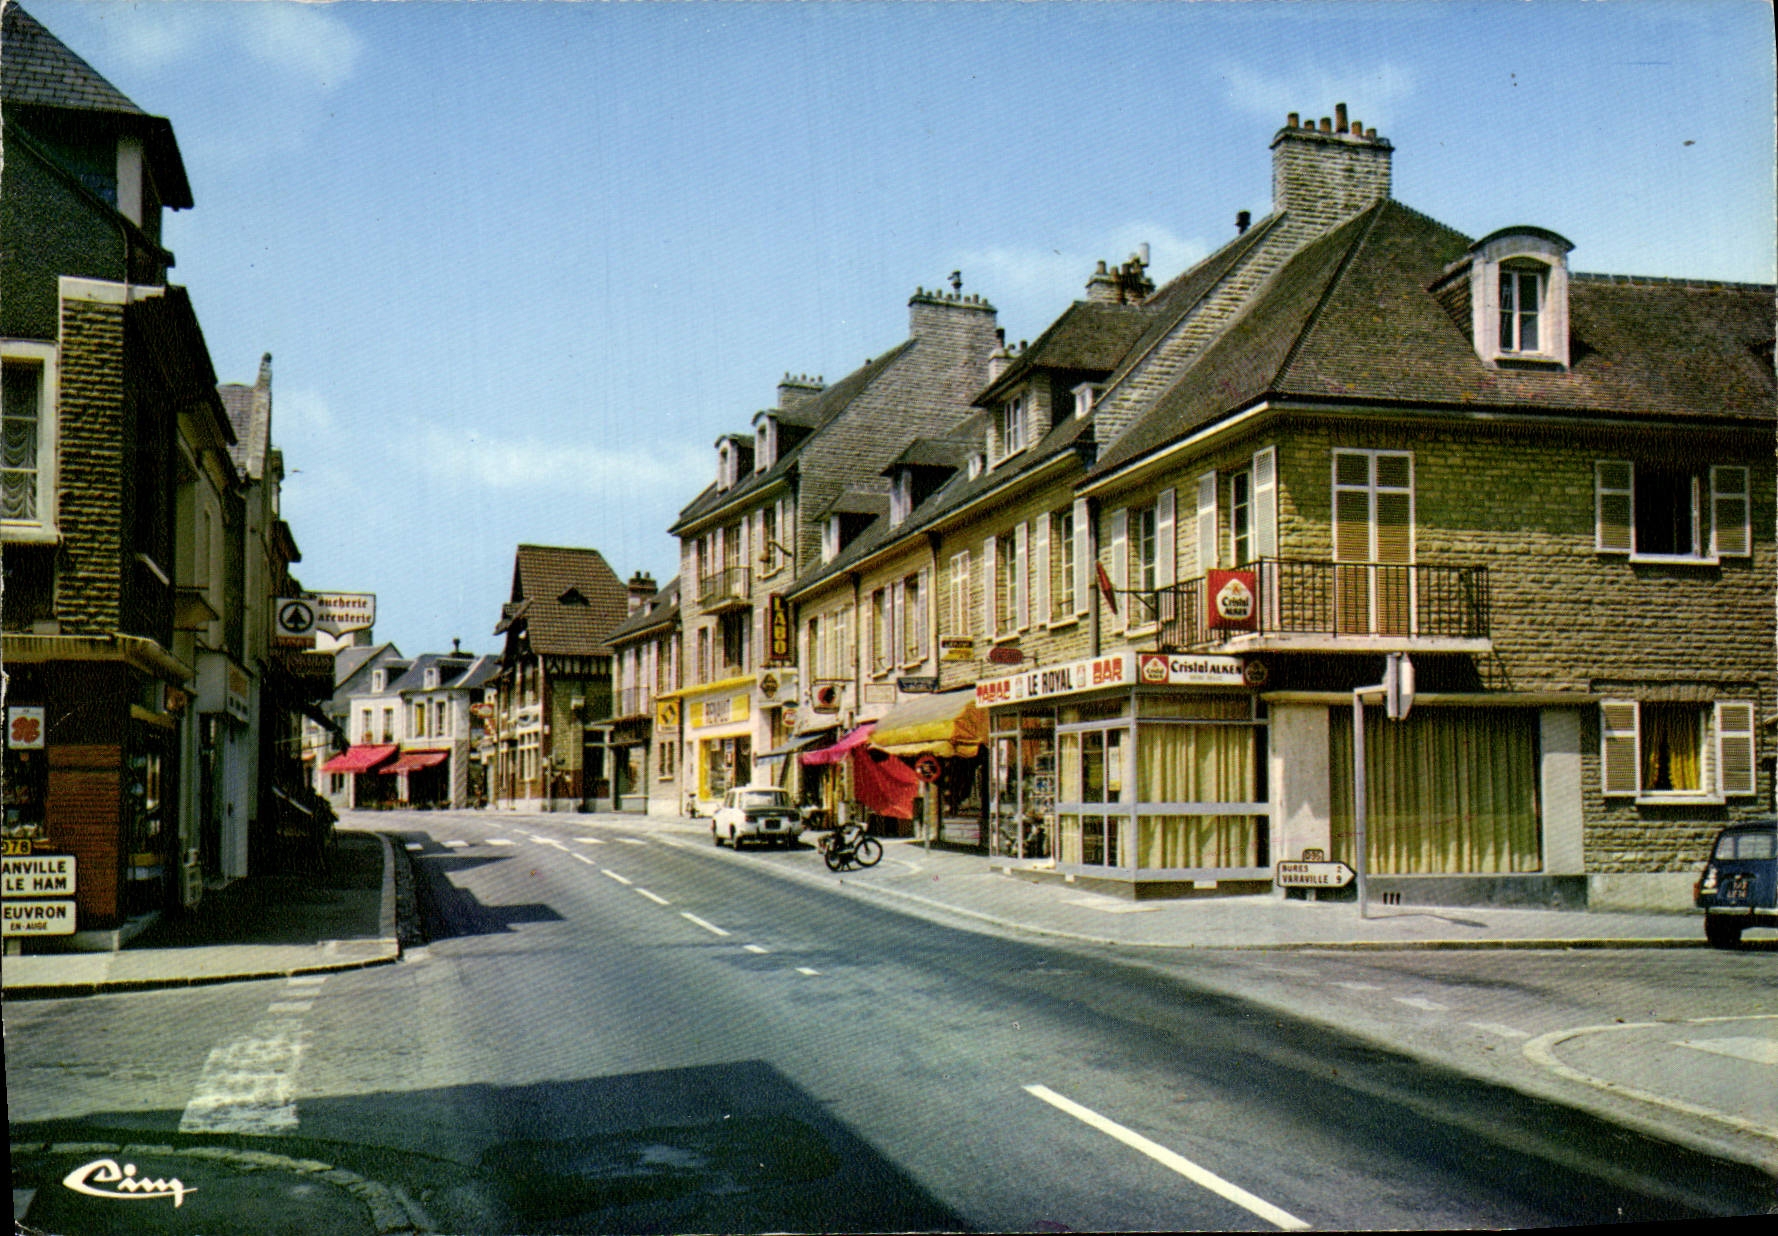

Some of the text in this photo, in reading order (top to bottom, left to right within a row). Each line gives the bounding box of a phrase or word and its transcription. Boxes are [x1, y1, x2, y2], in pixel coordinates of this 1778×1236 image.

[1170, 659, 1208, 673] Cristal
[1210, 664, 1242, 675] ALKEN
[976, 679, 1011, 704] TABAC
[1028, 674, 1038, 696] LE
[1042, 667, 1073, 694] ROYAL
[1092, 657, 1122, 685] BAR
[6, 876, 67, 891] LE HAM
[1281, 874, 1329, 884] VARAVILLE
[3, 905, 67, 920] EUVRON
